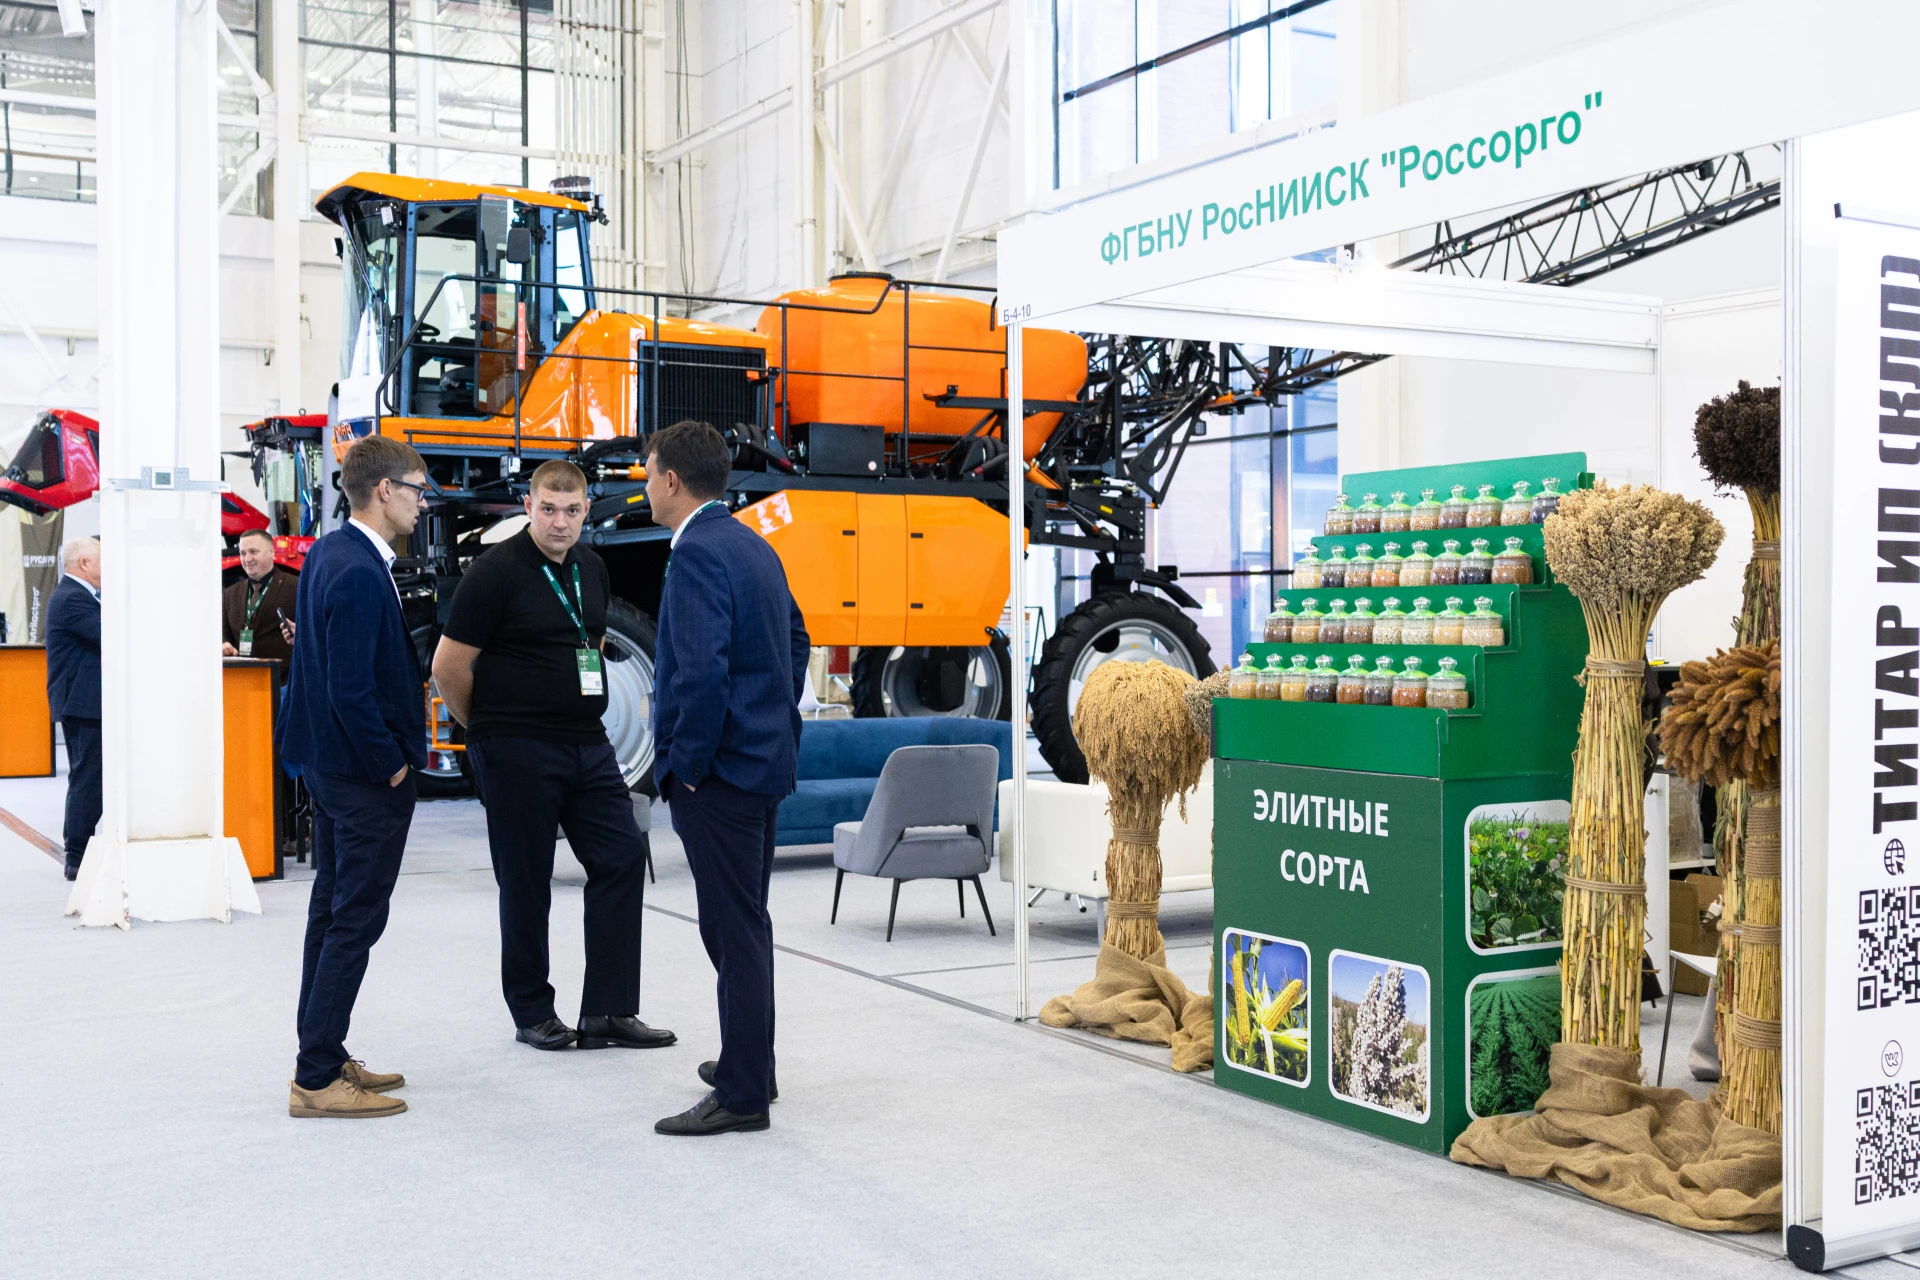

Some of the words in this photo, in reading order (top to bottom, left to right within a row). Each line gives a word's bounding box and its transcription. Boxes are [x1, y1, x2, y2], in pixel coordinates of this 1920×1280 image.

[1101, 209, 1193, 265] ФГБНУ
[1202, 157, 1370, 241] РосНИИСК
[1380, 90, 1603, 189] "Россорго"
[1003, 303, 1032, 323] Б-4-10
[1876, 487, 1920, 583] ИП
[1873, 604, 1920, 834] ТИТАР
[1253, 788, 1390, 838] ЭЛИТНЫЕ
[1279, 848, 1370, 895] СОРТА
